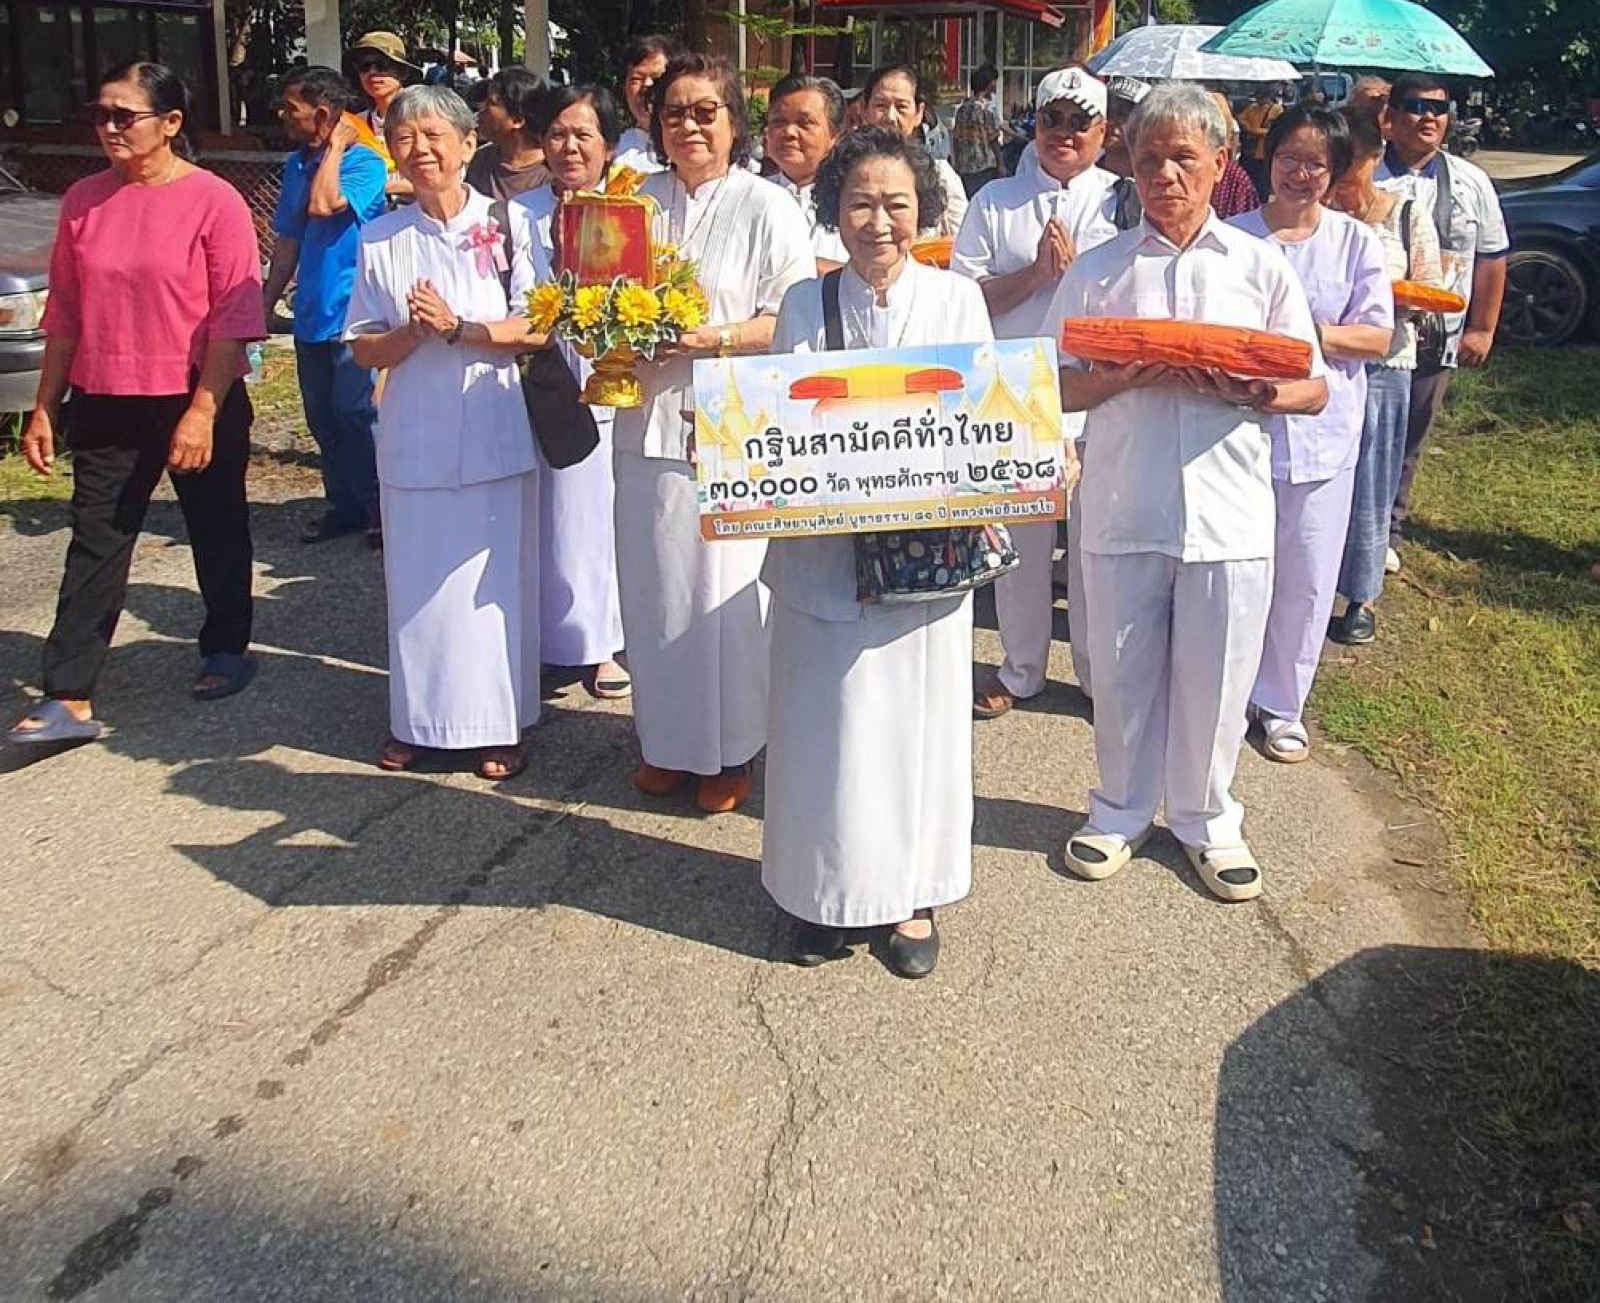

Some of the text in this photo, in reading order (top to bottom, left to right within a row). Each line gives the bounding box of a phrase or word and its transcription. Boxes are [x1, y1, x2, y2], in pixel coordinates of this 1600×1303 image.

[745, 407, 1014, 467] กฐินสามัคคีทั่วไทย
[709, 457, 1056, 502] ๓๐,๐๐๐ วัด พุทธศักราช ๒๕๖๘
